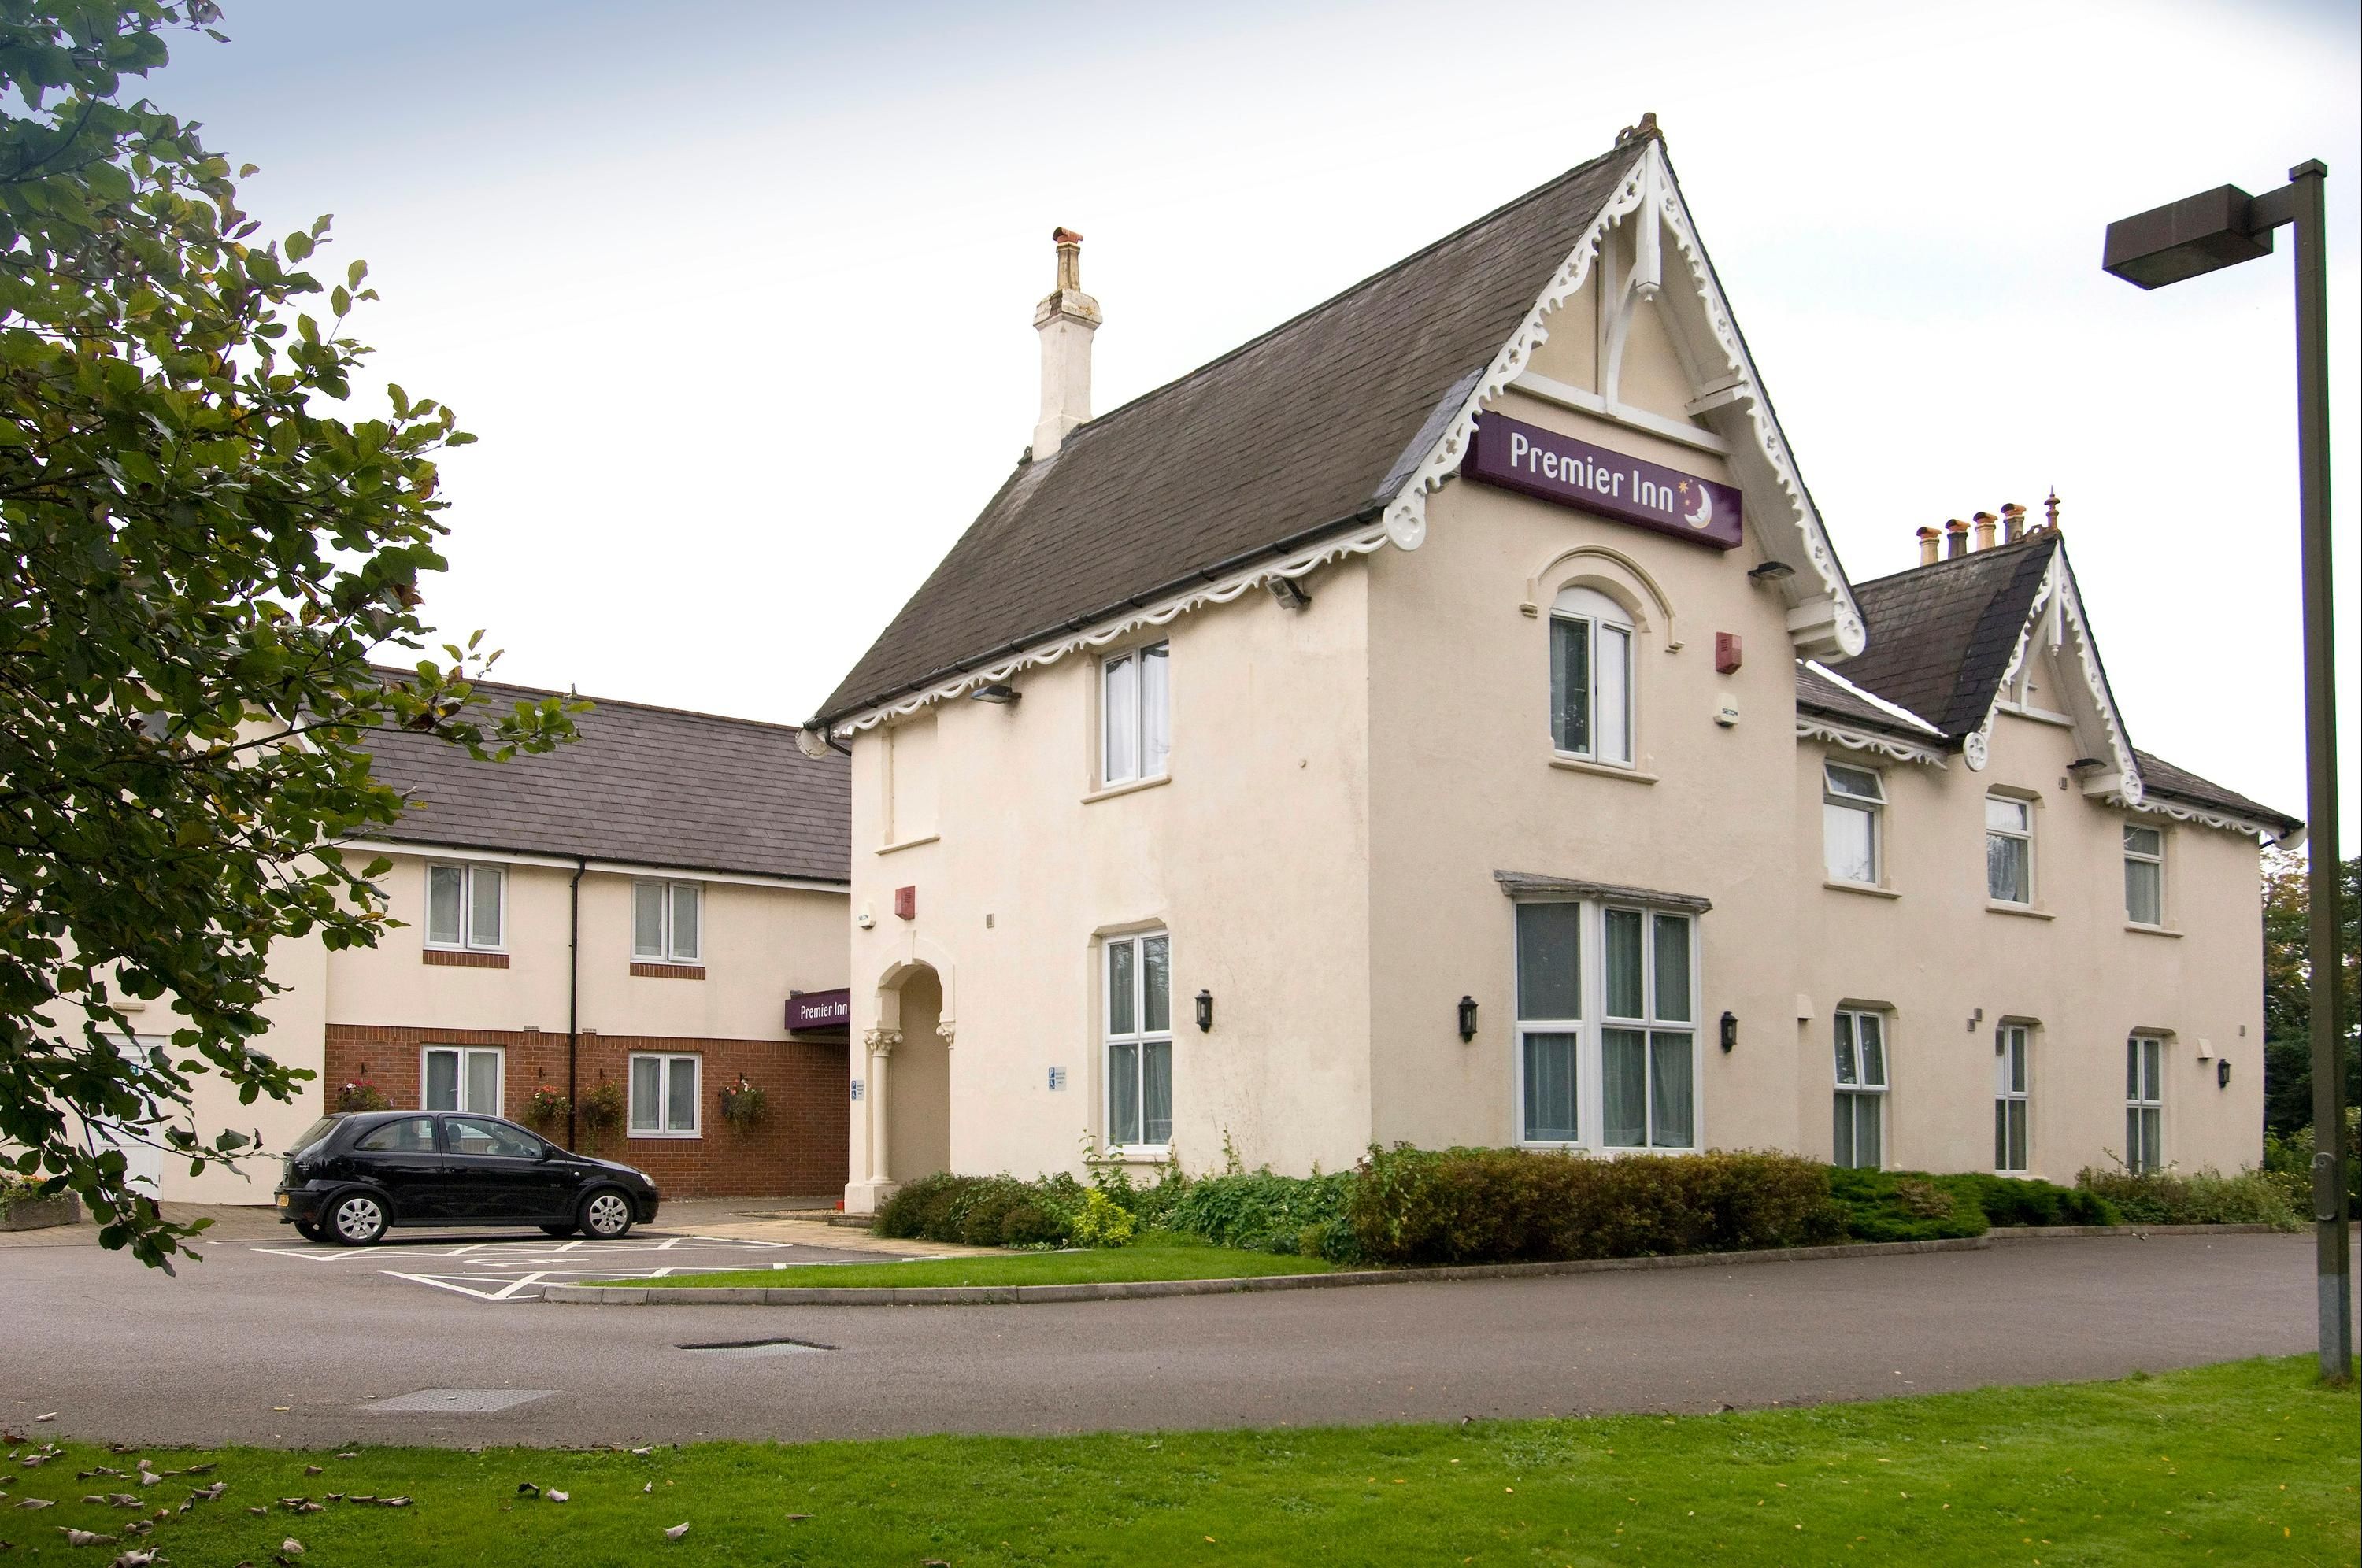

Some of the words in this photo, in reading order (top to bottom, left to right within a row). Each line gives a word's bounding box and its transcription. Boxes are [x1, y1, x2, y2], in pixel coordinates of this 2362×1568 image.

[1512, 432, 1624, 497] Premier
[1633, 470, 1673, 512] Inn
[800, 1003, 832, 1019] Premier
[835, 1001, 847, 1015] Inn
